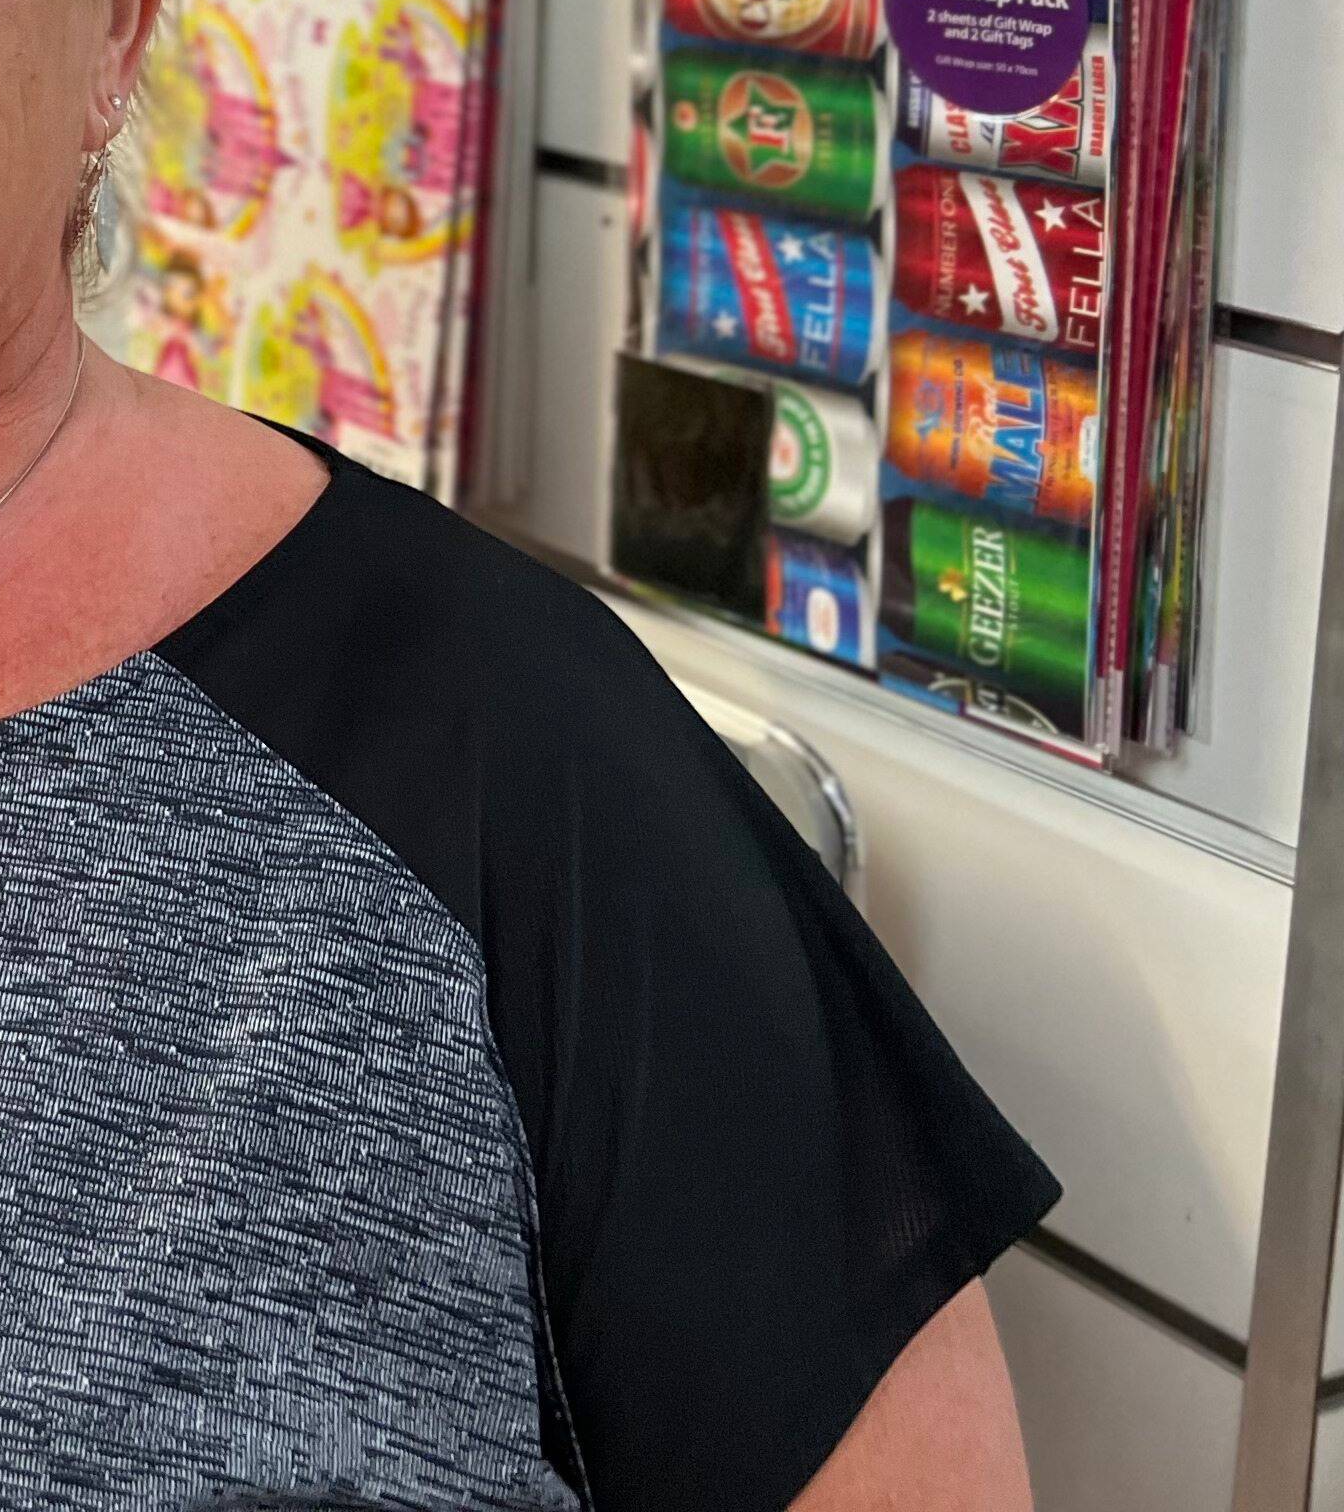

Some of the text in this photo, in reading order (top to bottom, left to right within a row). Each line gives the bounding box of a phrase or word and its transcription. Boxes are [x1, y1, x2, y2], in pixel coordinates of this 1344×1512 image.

[927, 9, 1052, 37] 2 sheets of Gift Wrap
[935, 55, 952, 66] Gift
[953, 57, 975, 69] Wrap
[944, 27, 1034, 49] and 2 Gift Tags
[1090, 56, 1106, 157] DRAUGHT LAGER
[798, 233, 836, 370] FELLA
[934, 220, 958, 317] NUMBER
[1065, 197, 1104, 348] FELLA
[985, 345, 1045, 513] MALE
[969, 525, 1005, 667] GEEZER
